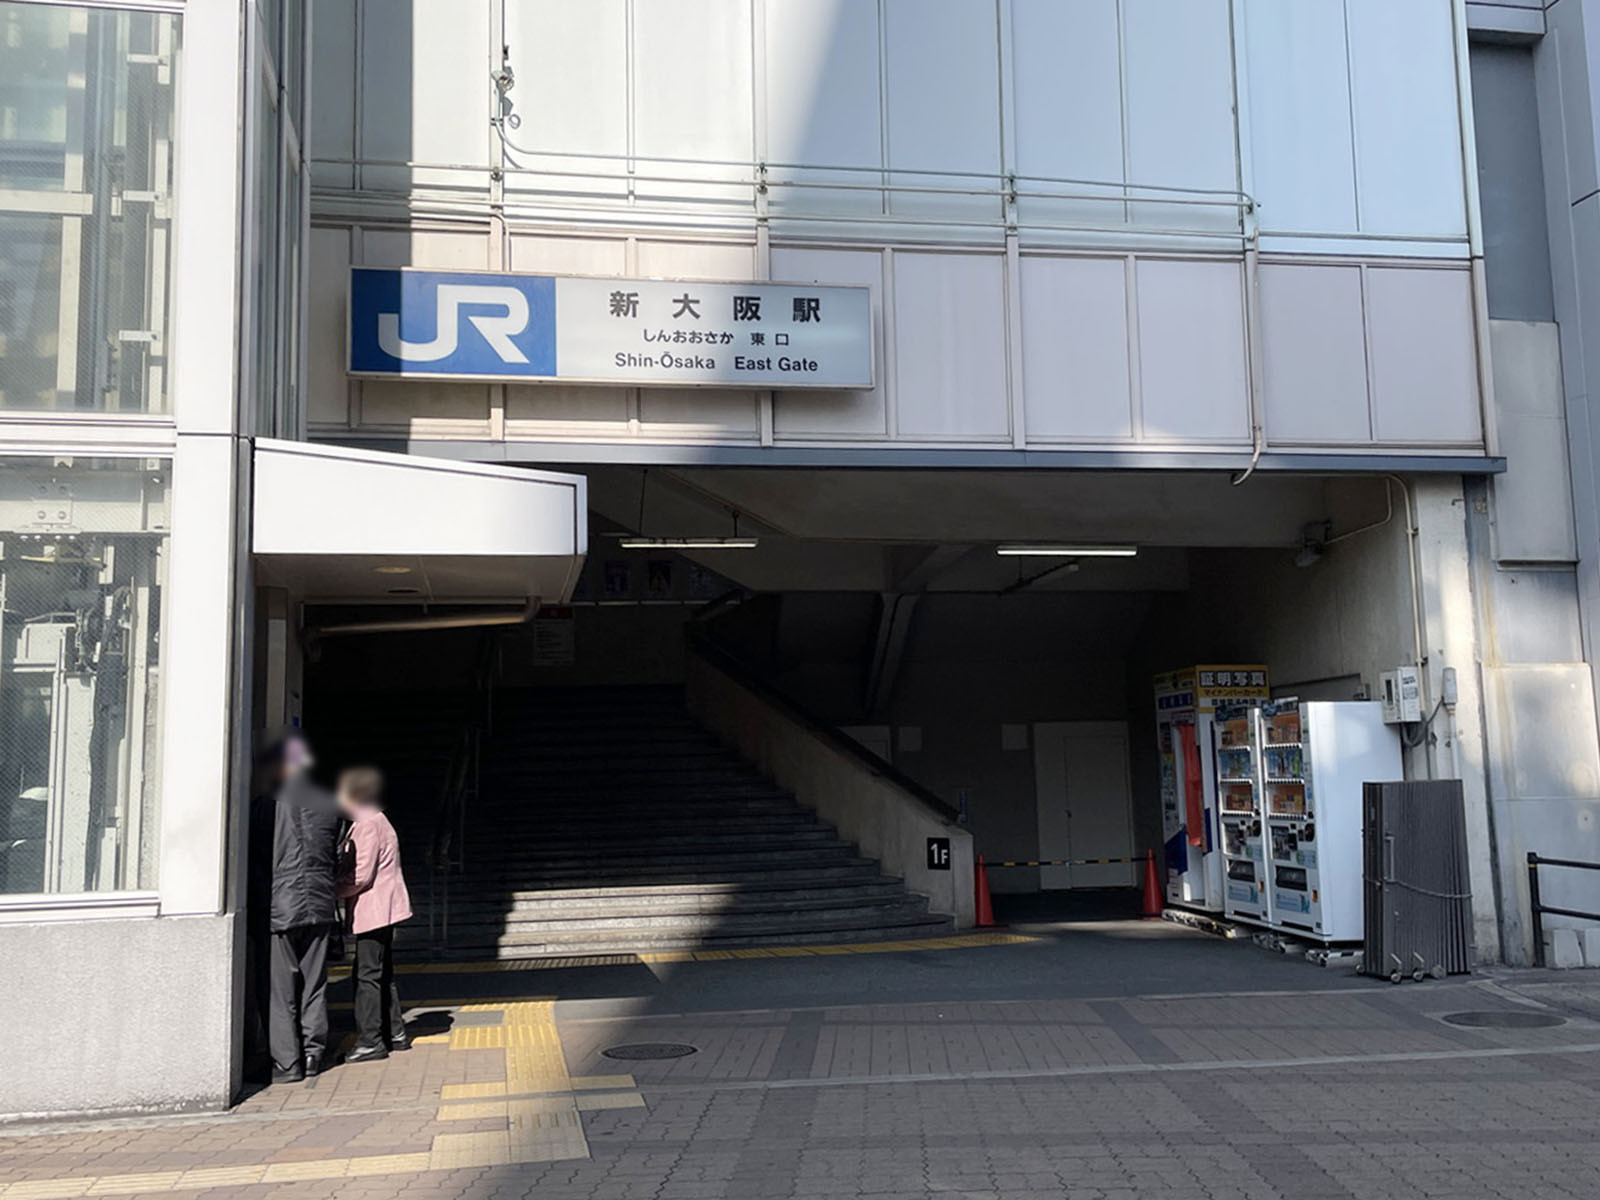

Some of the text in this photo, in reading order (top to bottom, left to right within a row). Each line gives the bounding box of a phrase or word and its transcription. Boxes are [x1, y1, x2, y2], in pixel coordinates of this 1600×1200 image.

[609, 291, 821, 323] 新大阪駅
[379, 284, 530, 363] JR
[643, 328, 789, 346] しんおおさか 東口
[615, 351, 818, 373] Shin-Ōsaka East Gate
[1200, 671, 1265, 686] 証明写真
[930, 843, 948, 864] 1F
